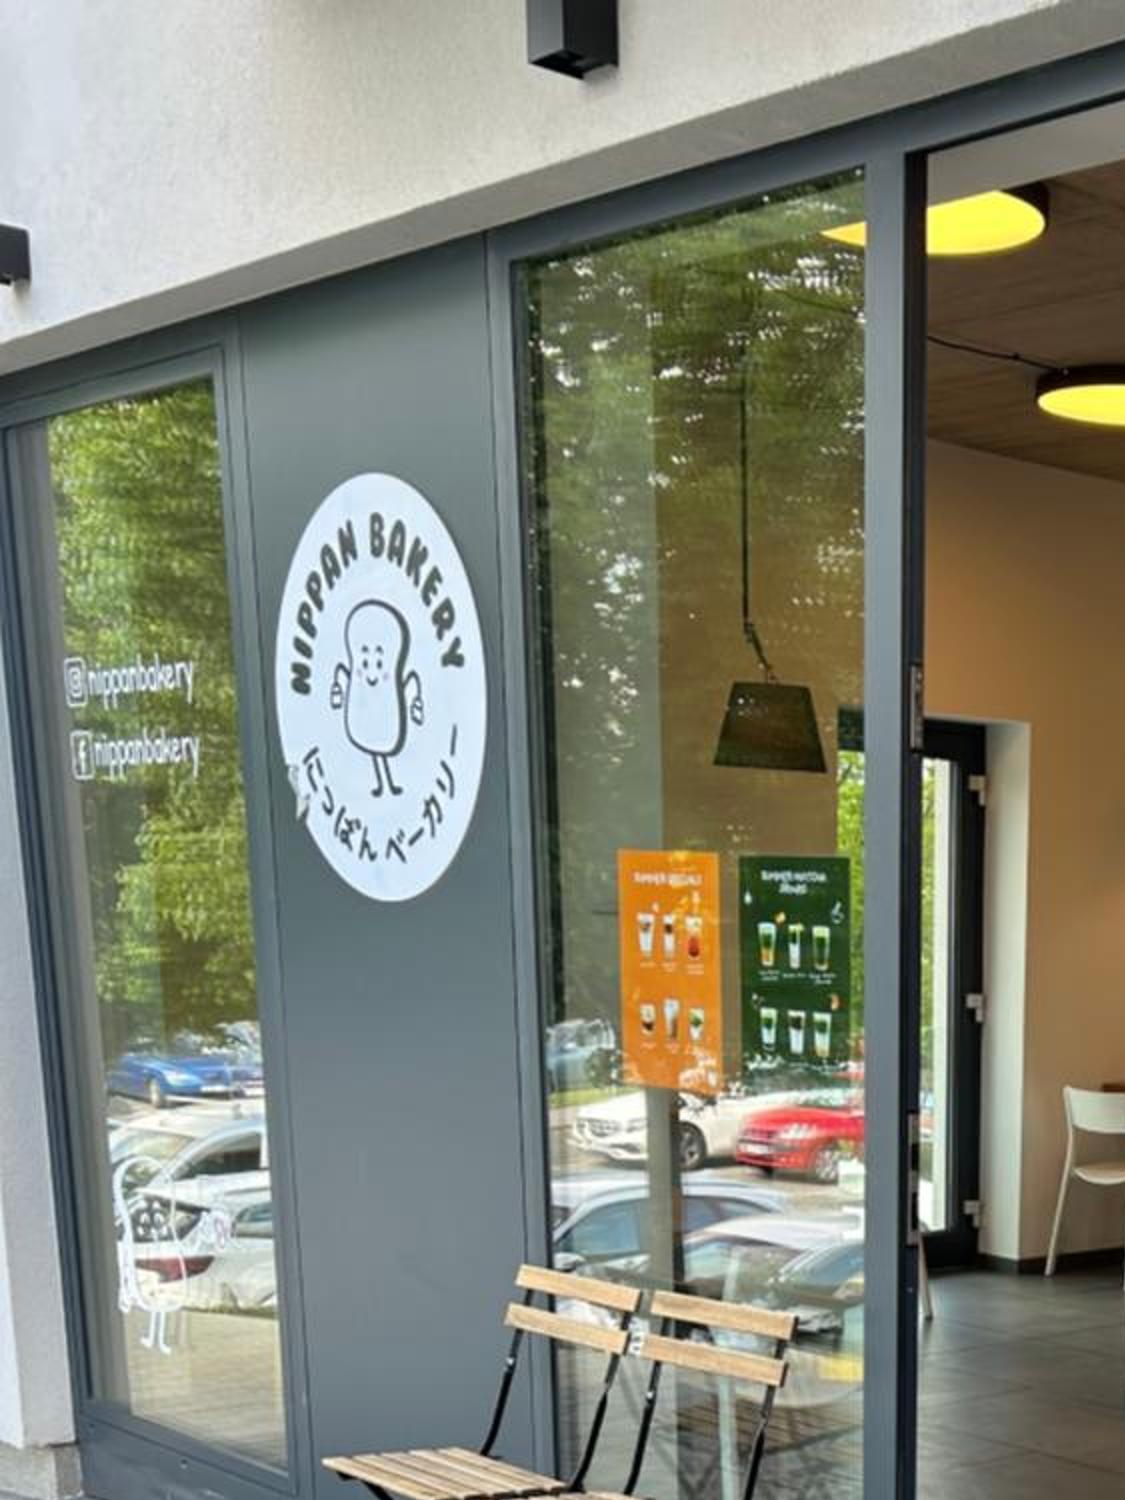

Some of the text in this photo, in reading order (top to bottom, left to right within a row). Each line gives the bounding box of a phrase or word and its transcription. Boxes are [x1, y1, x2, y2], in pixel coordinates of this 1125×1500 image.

[291, 512, 464, 695] NIPPAN BAKERY
[87, 652, 193, 710] nippanbakery
[94, 726, 199, 783] nippanbakery
